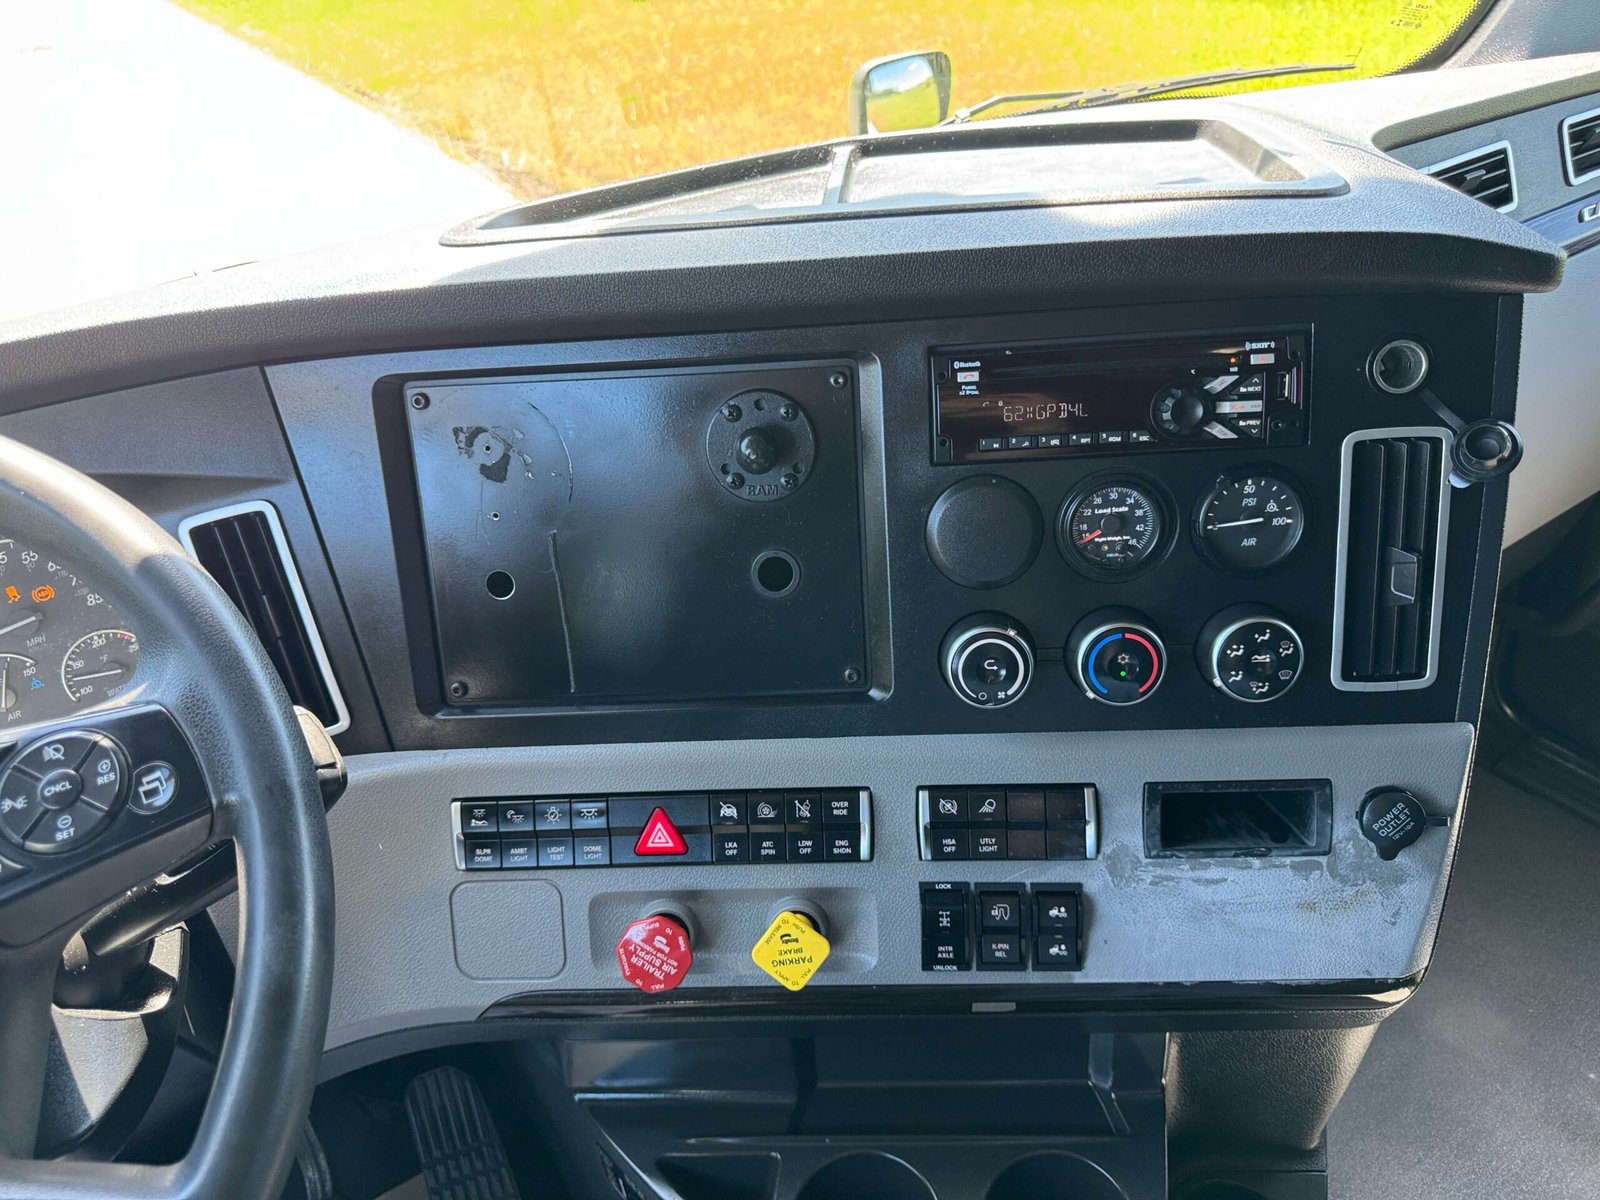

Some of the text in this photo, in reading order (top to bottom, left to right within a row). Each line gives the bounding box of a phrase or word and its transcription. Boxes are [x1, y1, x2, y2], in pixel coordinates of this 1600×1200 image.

[746, 484, 779, 496] RAM
[1243, 485, 1255, 494] 50
[1242, 498, 1257, 506] PSI
[1272, 517, 1286, 526] 100
[1241, 538, 1257, 546] AIR
[26, 635, 46, 647] MPH
[92, 638, 107, 648] 200
[72, 660, 85, 669] 150
[23, 667, 36, 678] 150
[80, 686, 93, 695] 100
[8, 710, 22, 721] AIR
[96, 772, 116, 786] RES
[44, 781, 72, 796] CNCL
[1372, 802, 1405, 831] POWER
[1379, 808, 1411, 837] OUTLET
[56, 828, 76, 841] SET
[792, 922, 806, 934] PUSH
[629, 944, 662, 966] SUPPLY
[656, 950, 668, 961] FOR
[778, 947, 803, 956] BRAKE
[666, 956, 679, 967] NOT
[771, 956, 813, 967] PARKING
[631, 955, 665, 980] TRAILER
[662, 963, 677, 975] AIR
[775, 970, 790, 982] APPLY
[801, 968, 812, 979] PULL
